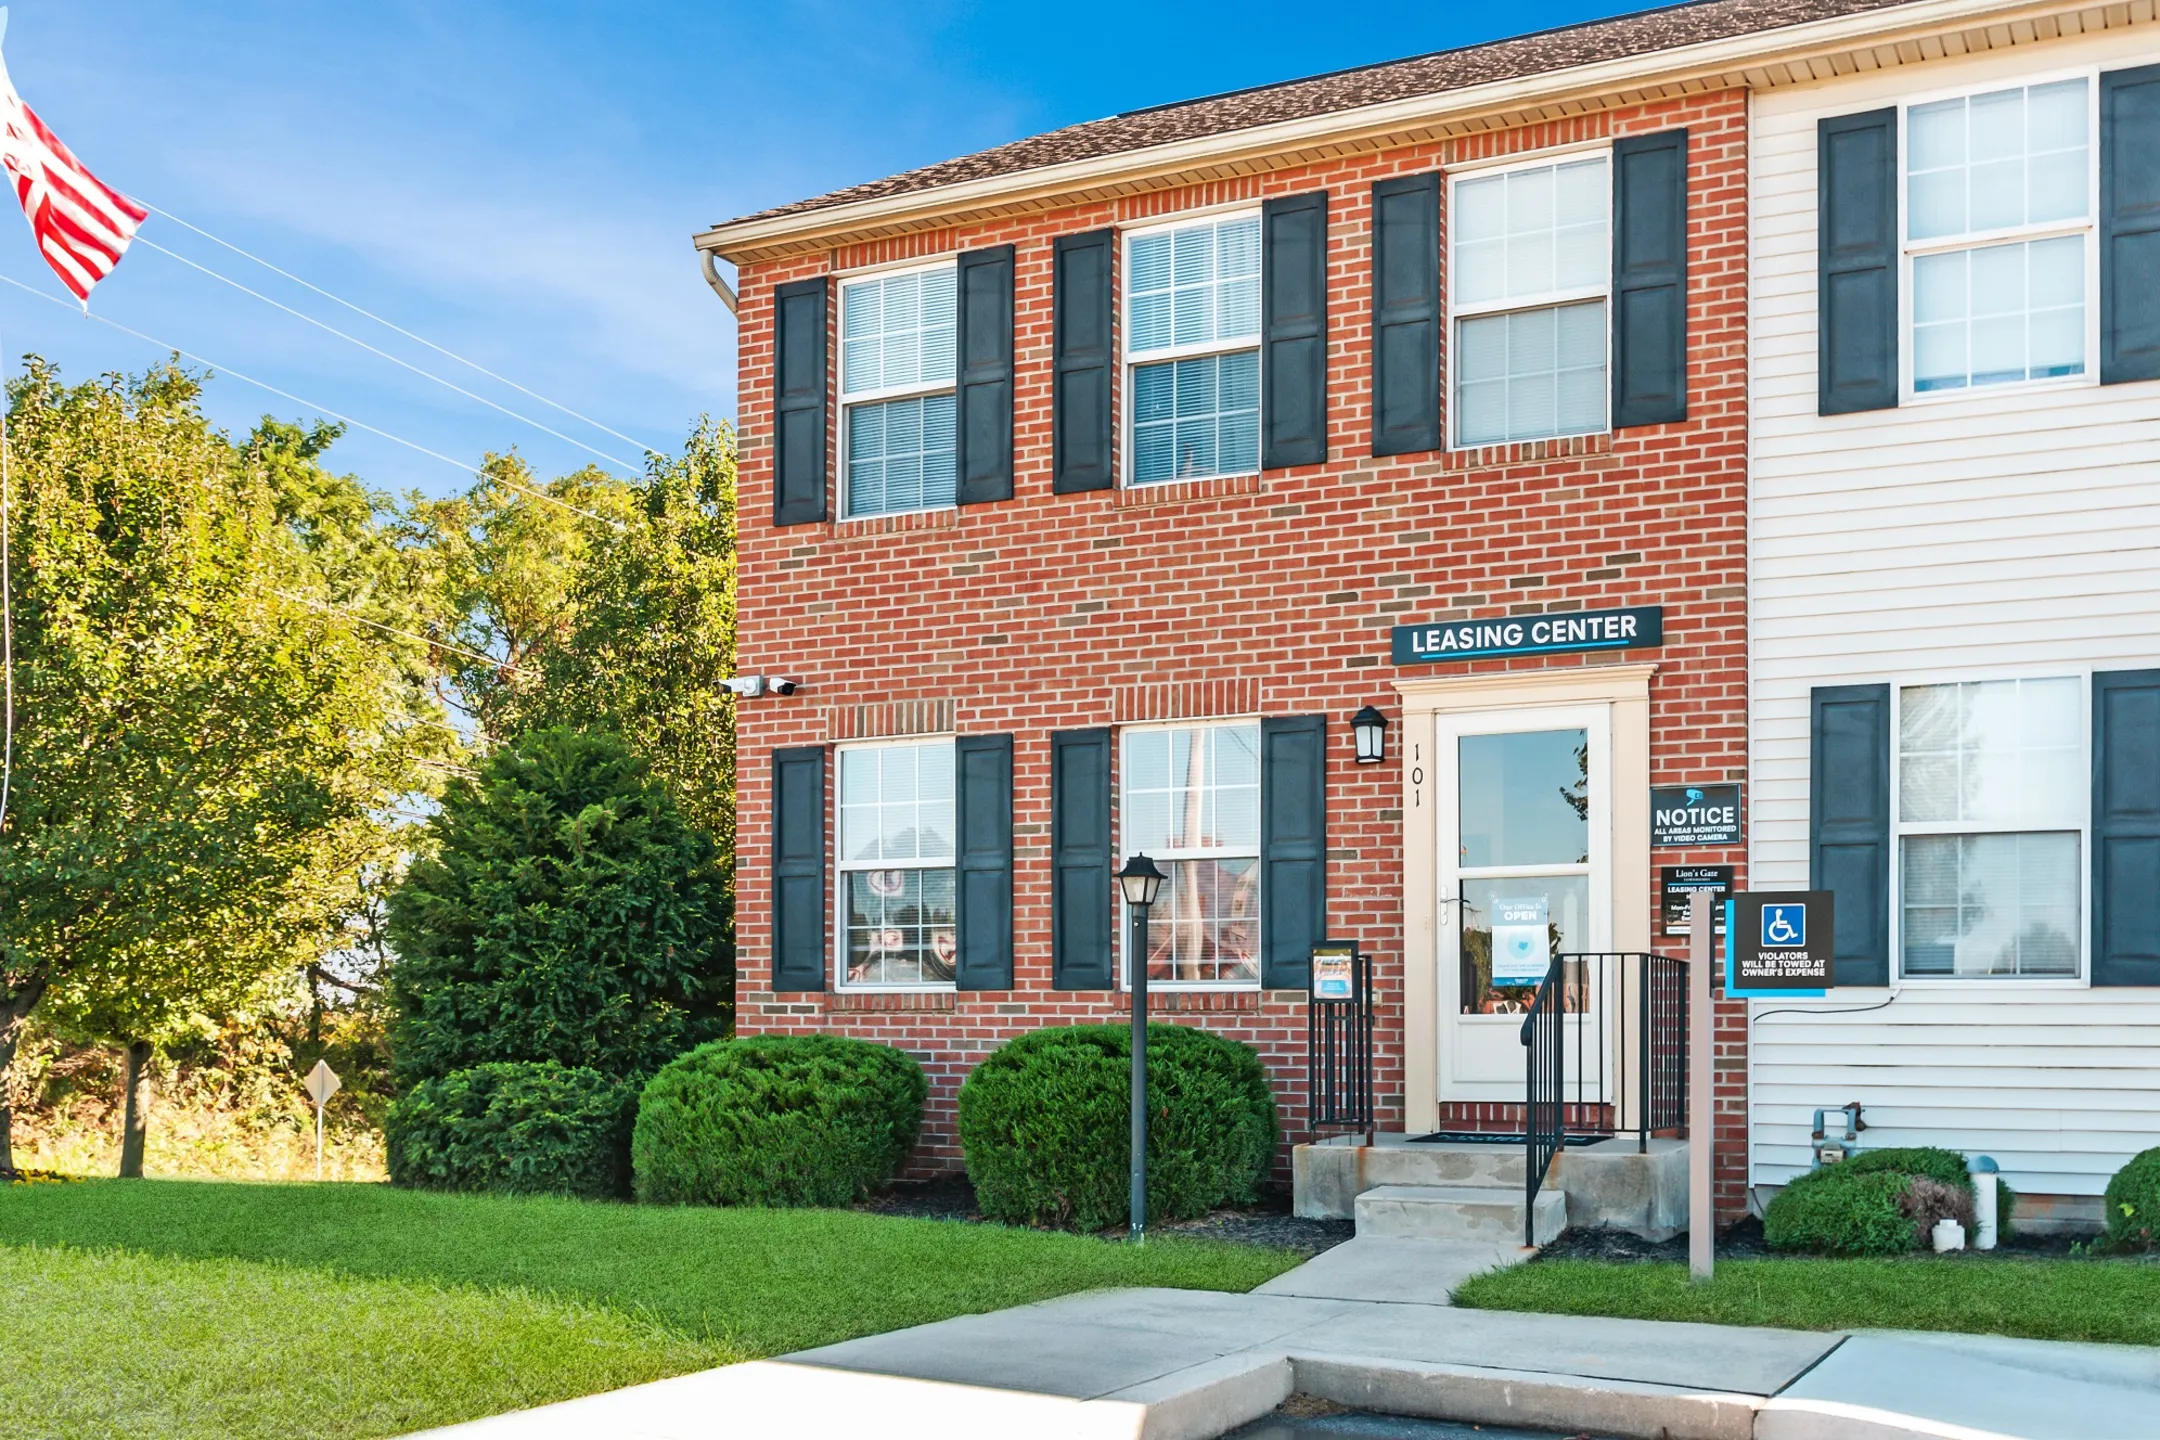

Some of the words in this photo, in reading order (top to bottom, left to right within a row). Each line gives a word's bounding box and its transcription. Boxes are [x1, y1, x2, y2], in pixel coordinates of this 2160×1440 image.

[1412, 623, 1523, 653] LEASING
[1531, 615, 1637, 643] CENTER
[1412, 743, 1423, 807] 101
[1656, 807, 1734, 826] NOTICE
[1668, 827, 1691, 835] AREAS
[1693, 825, 1737, 833] MONITORED
[1673, 834, 1696, 842] VIDEO
[1697, 833, 1727, 841] CAMERA
[1675, 868, 1699, 878] Lion's
[1700, 868, 1718, 877] Gate
[1698, 885, 1726, 893] CENTER
[1504, 910, 1537, 921] OPEN
[1758, 952, 1808, 960] VIOLATORS
[1741, 960, 1763, 968] WILL
[1764, 960, 1777, 968] BE
[1778, 960, 1812, 968] TOWED
[1813, 959, 1825, 968] AT
[1741, 968, 1783, 976] OWNER'S
[1785, 967, 1825, 976] EXPENSE
